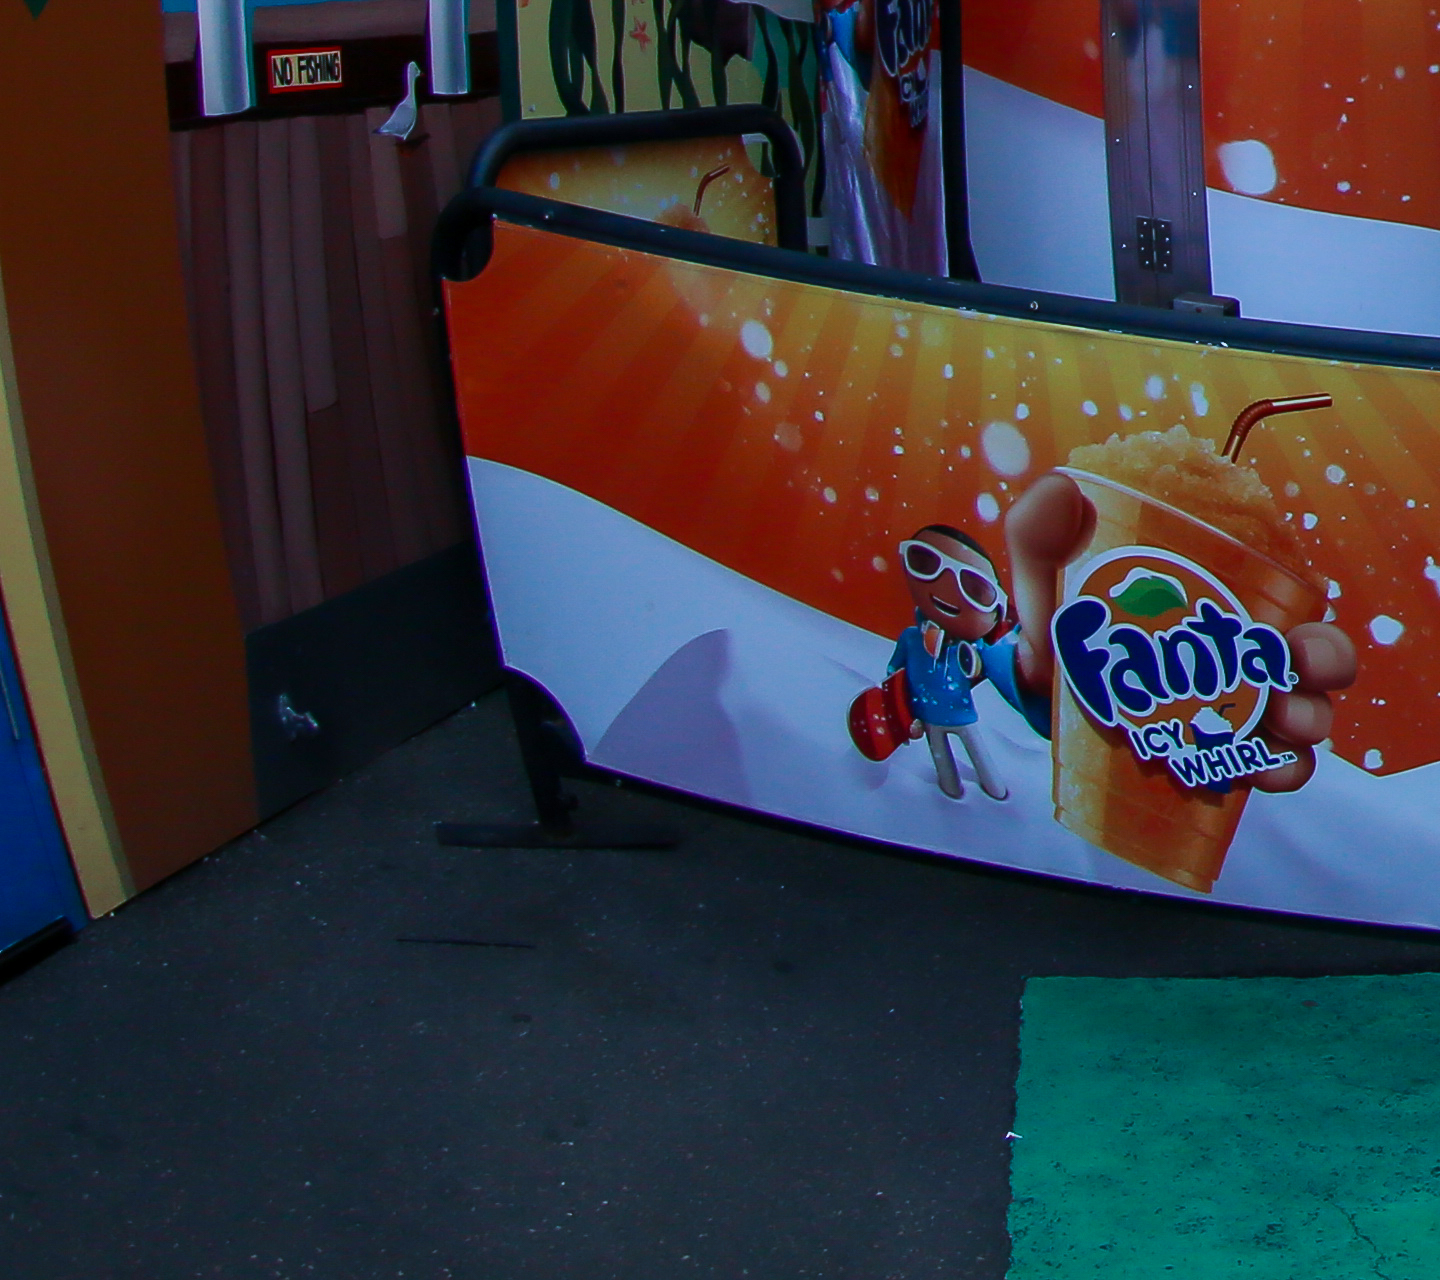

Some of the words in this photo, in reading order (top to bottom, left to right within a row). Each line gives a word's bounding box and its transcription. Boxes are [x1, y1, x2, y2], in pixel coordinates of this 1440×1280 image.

[272, 56, 294, 86] NO
[298, 52, 341, 84] FISHING
[1055, 601, 1288, 724] Fanta
[1131, 720, 1185, 759] ICY
